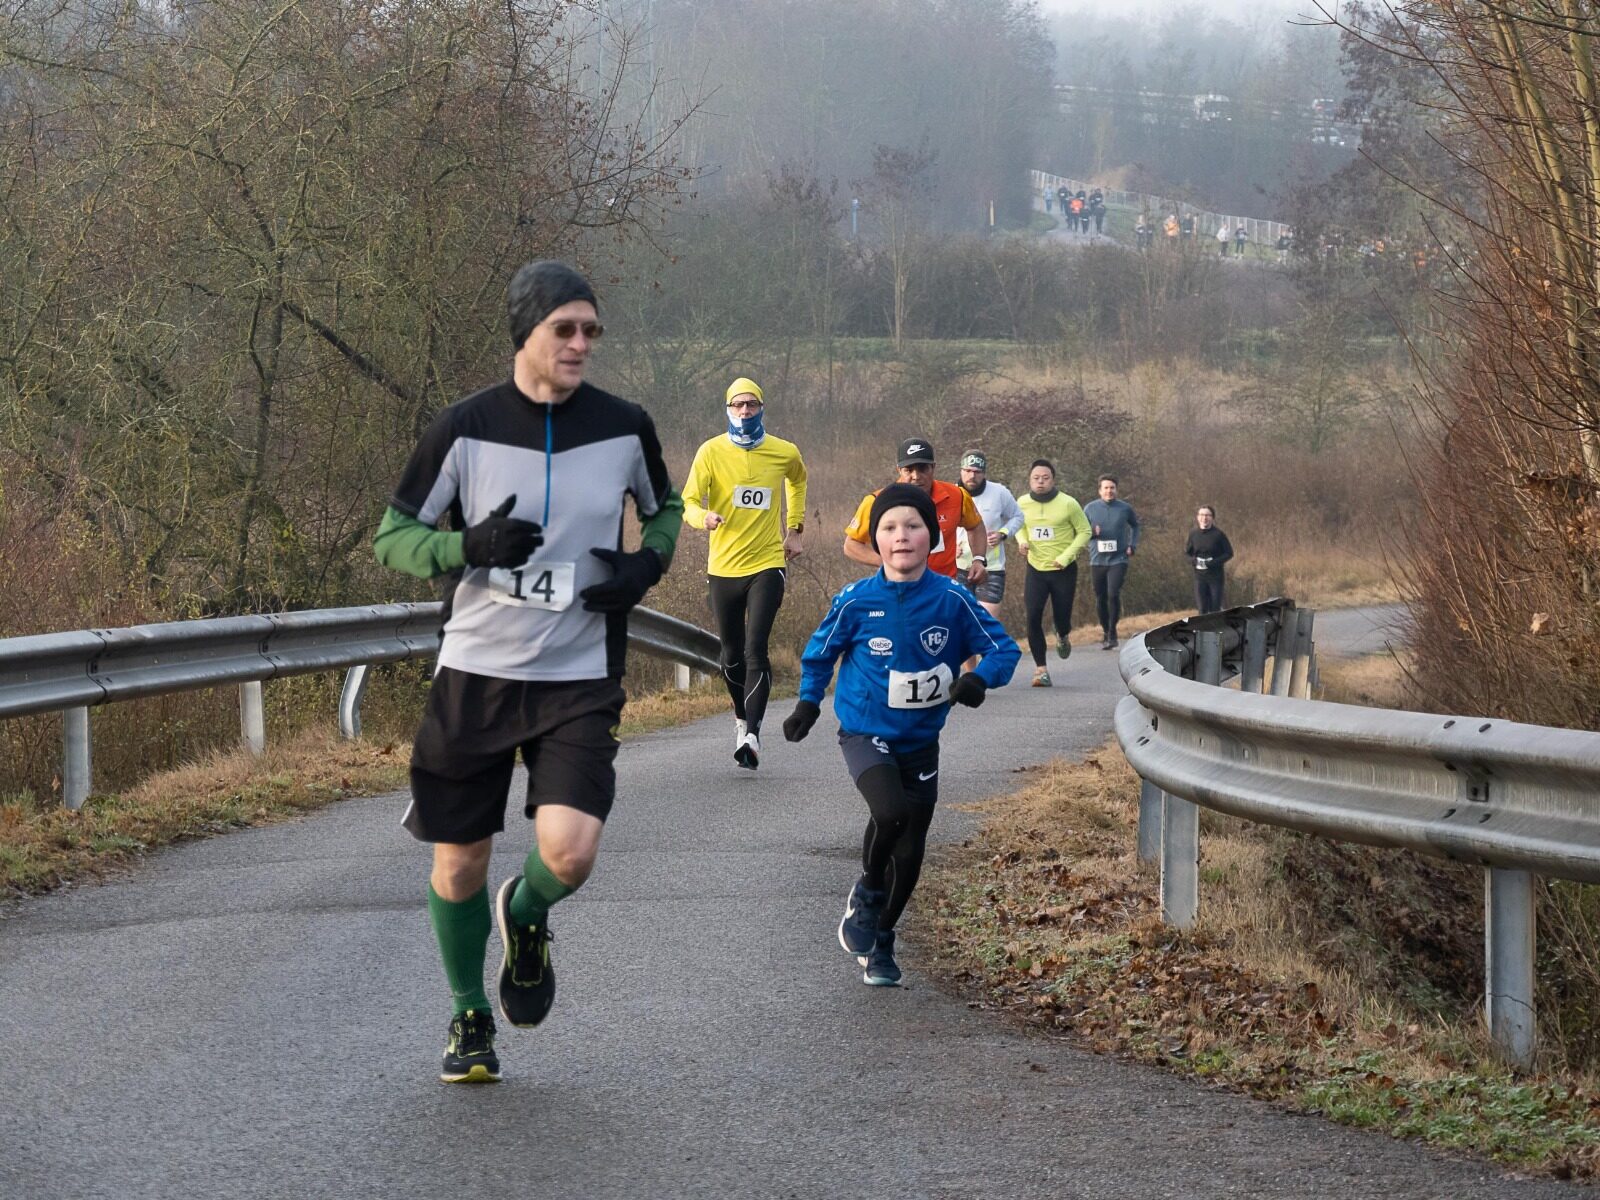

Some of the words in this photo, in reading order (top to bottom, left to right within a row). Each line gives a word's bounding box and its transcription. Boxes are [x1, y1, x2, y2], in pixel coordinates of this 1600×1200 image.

[741, 489, 763, 506] 60
[1036, 528, 1049, 538] 74
[508, 569, 555, 603] 14
[868, 610, 885, 618] JAKO
[928, 632, 942, 647] FC
[905, 675, 943, 703] 12
